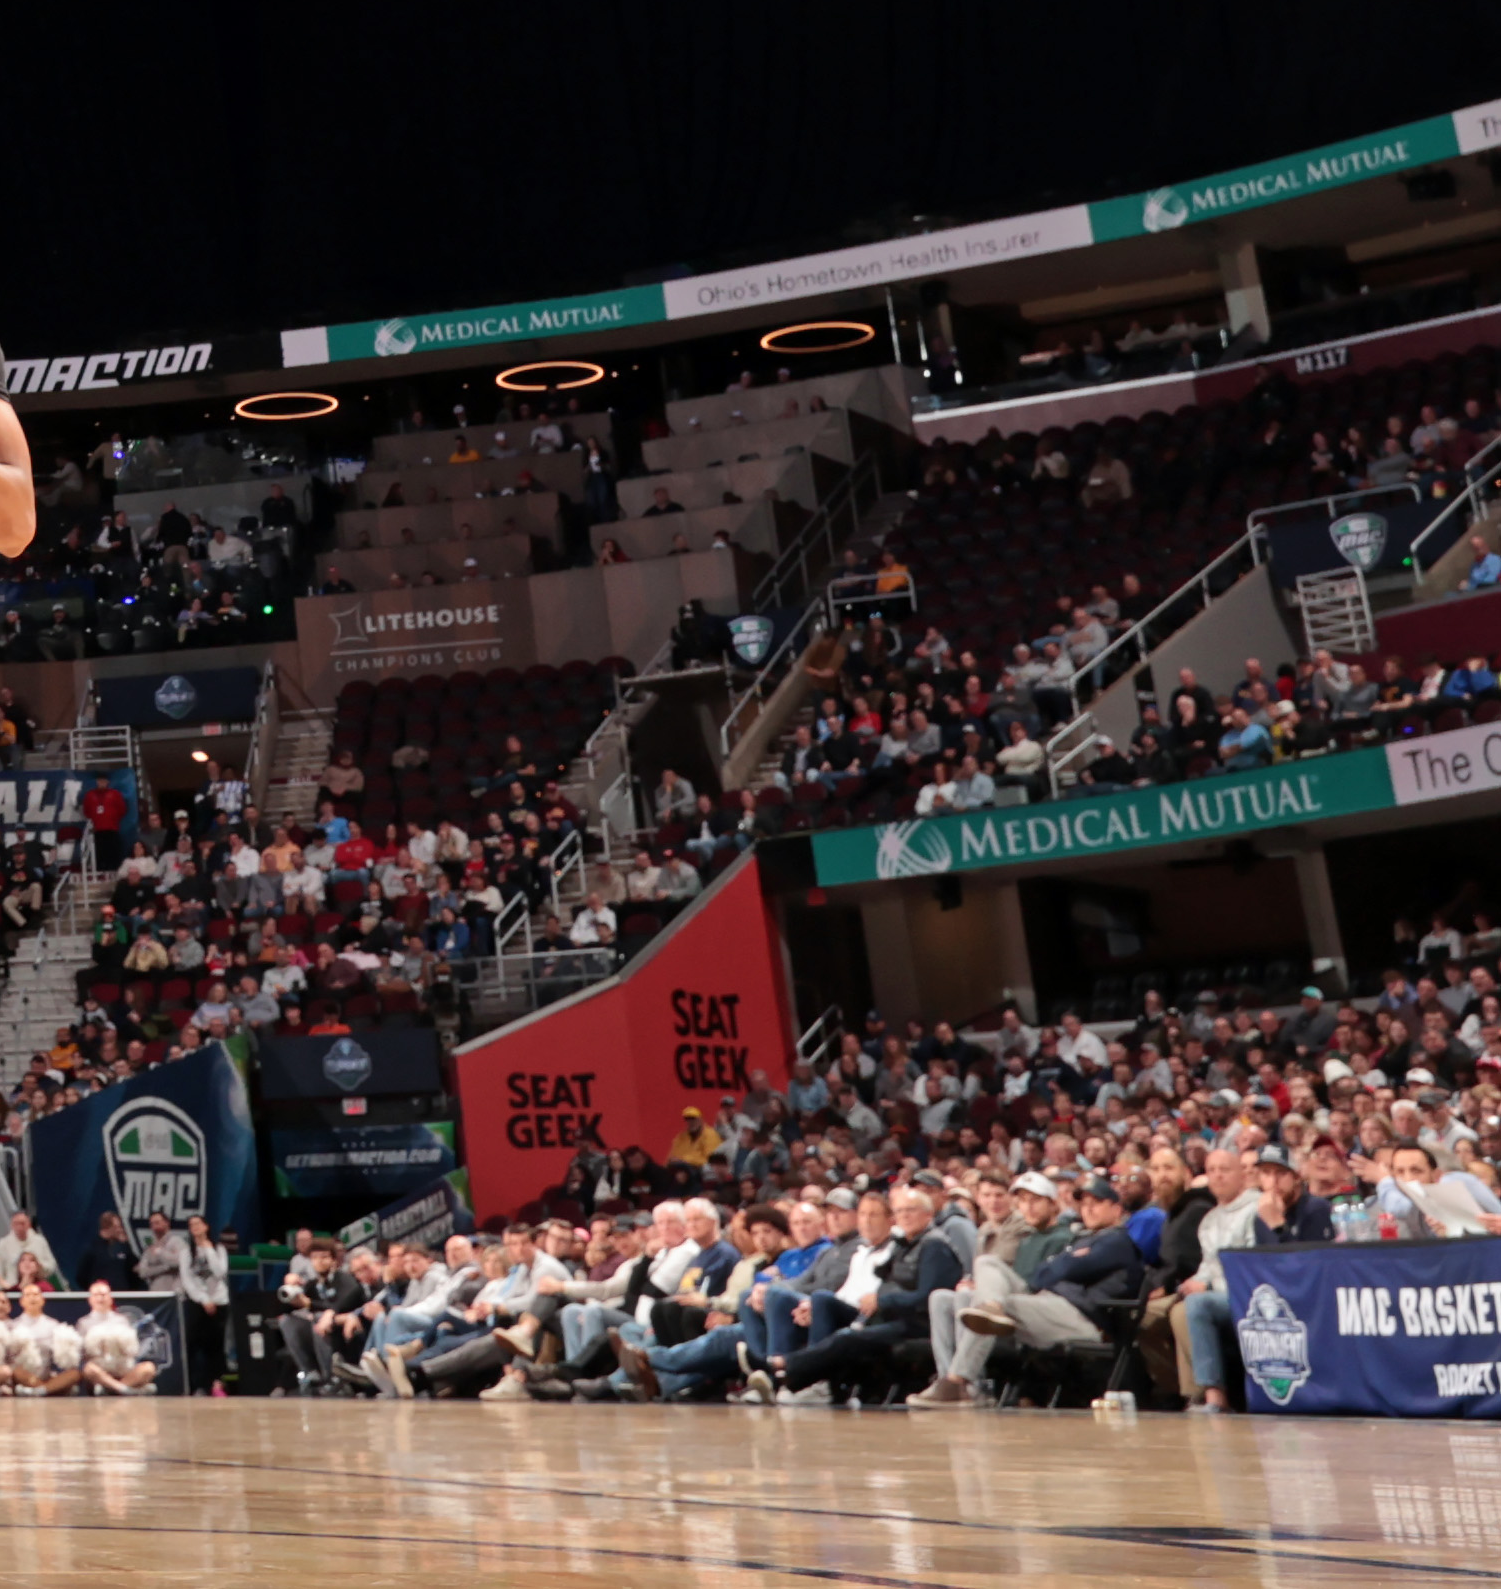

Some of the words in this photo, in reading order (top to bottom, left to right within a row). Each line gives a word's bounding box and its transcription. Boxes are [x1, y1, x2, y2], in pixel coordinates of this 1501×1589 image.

[1192, 169, 1303, 213] MEDICAL
[1306, 140, 1409, 186] MUTUAL
[766, 259, 883, 294] Hometown
[889, 244, 958, 274] Health
[421, 317, 523, 345] MEDICAL
[529, 303, 624, 332] MUTUAL
[363, 605, 501, 634] LITEHOUSE
[334, 652, 444, 673] CHAMPIONS
[453, 646, 502, 666] CLUB
[1402, 748, 1471, 791] The
[960, 804, 1151, 862] MEDICAL
[1159, 773, 1322, 835] MUTUAL
[670, 987, 740, 1040] SEAT
[673, 1043, 751, 1092] GEEK
[506, 1071, 596, 1109] SEAT
[506, 1112, 607, 1150] GEEK
[1336, 1287, 1396, 1337] MAC
[1433, 1361, 1496, 1397] ROCKET
